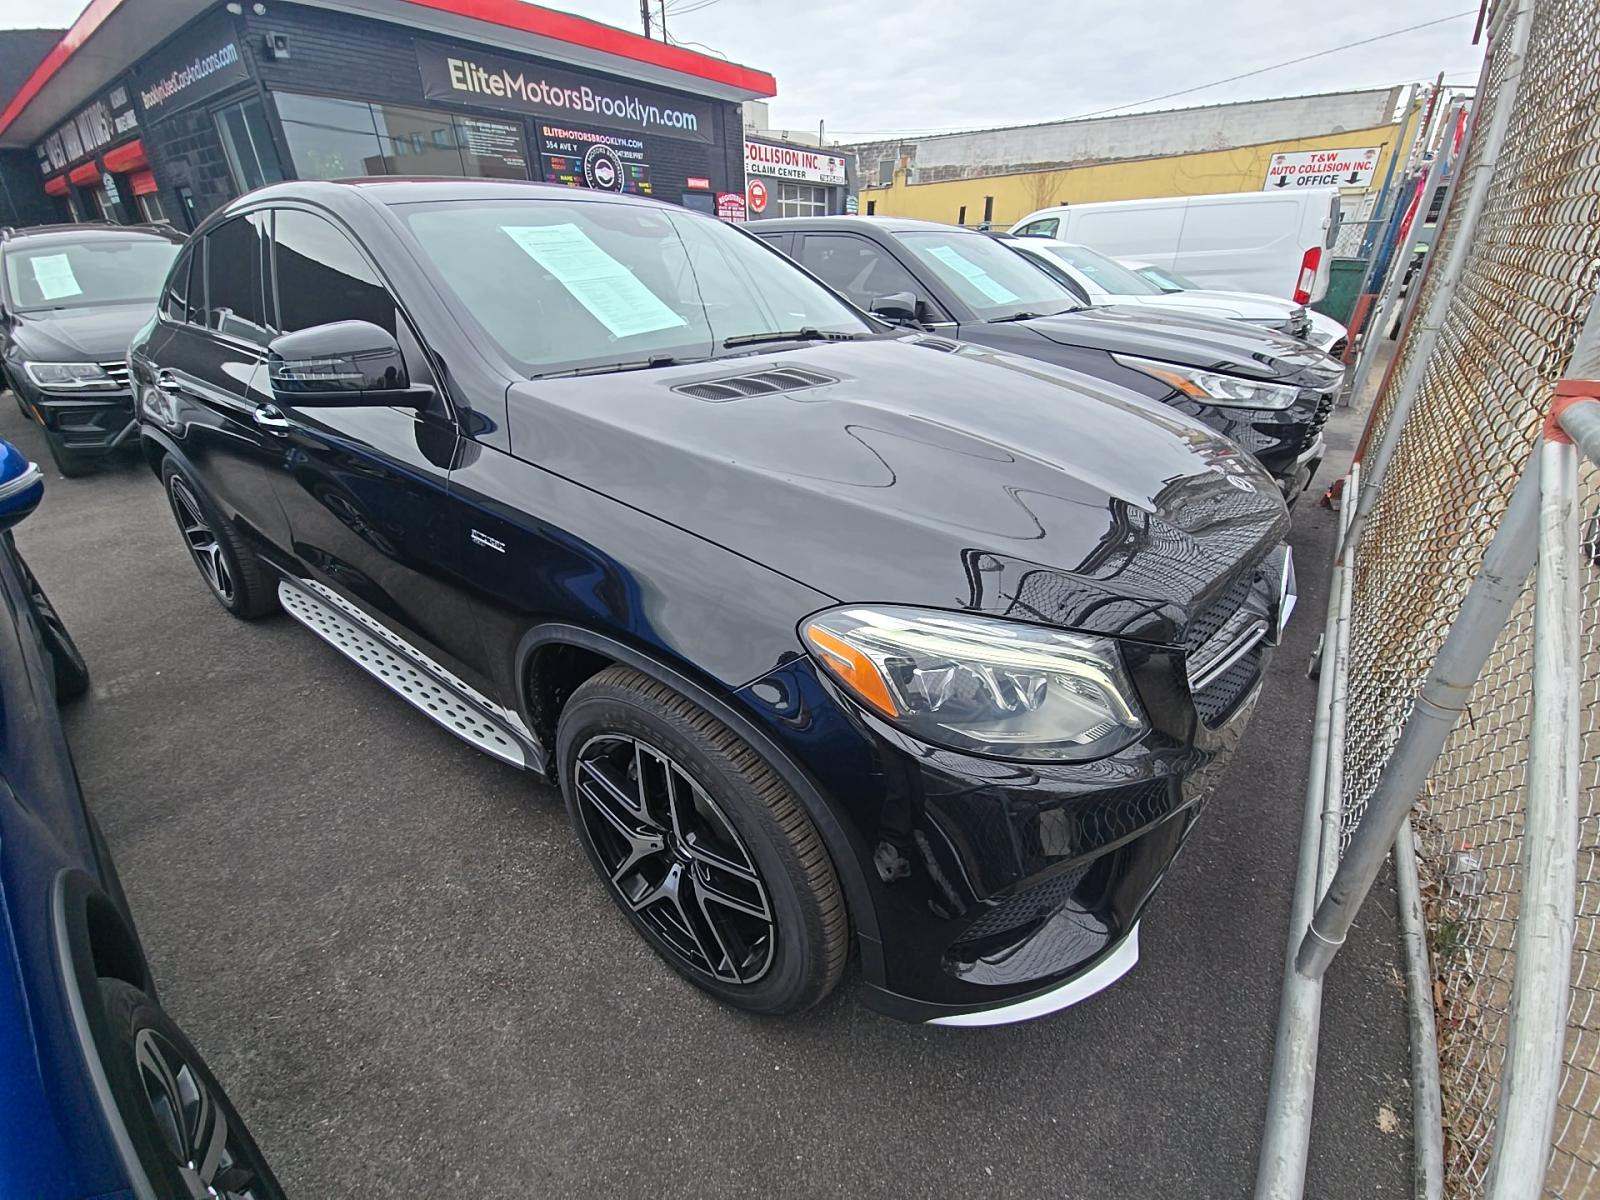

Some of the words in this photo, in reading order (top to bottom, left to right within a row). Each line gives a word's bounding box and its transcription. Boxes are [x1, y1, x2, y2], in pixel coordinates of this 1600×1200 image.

[447, 57, 698, 132] EliteMotorsBrooklyn.com
[543, 126, 643, 149] ELITEMOTORSBROOKLYN.COM
[546, 140, 558, 149] 354
[559, 142, 572, 151] AVE
[588, 147, 606, 161] MOTORS
[1310, 153, 1339, 163] T&W
[802, 154, 821, 170] INC.
[1270, 164, 1296, 176] AUTO
[1298, 162, 1351, 174] COLLISION
[1353, 161, 1373, 171] INC.
[751, 163, 776, 174] CLAIM
[777, 167, 807, 178] CENTER
[1297, 174, 1339, 186] OFFICE
